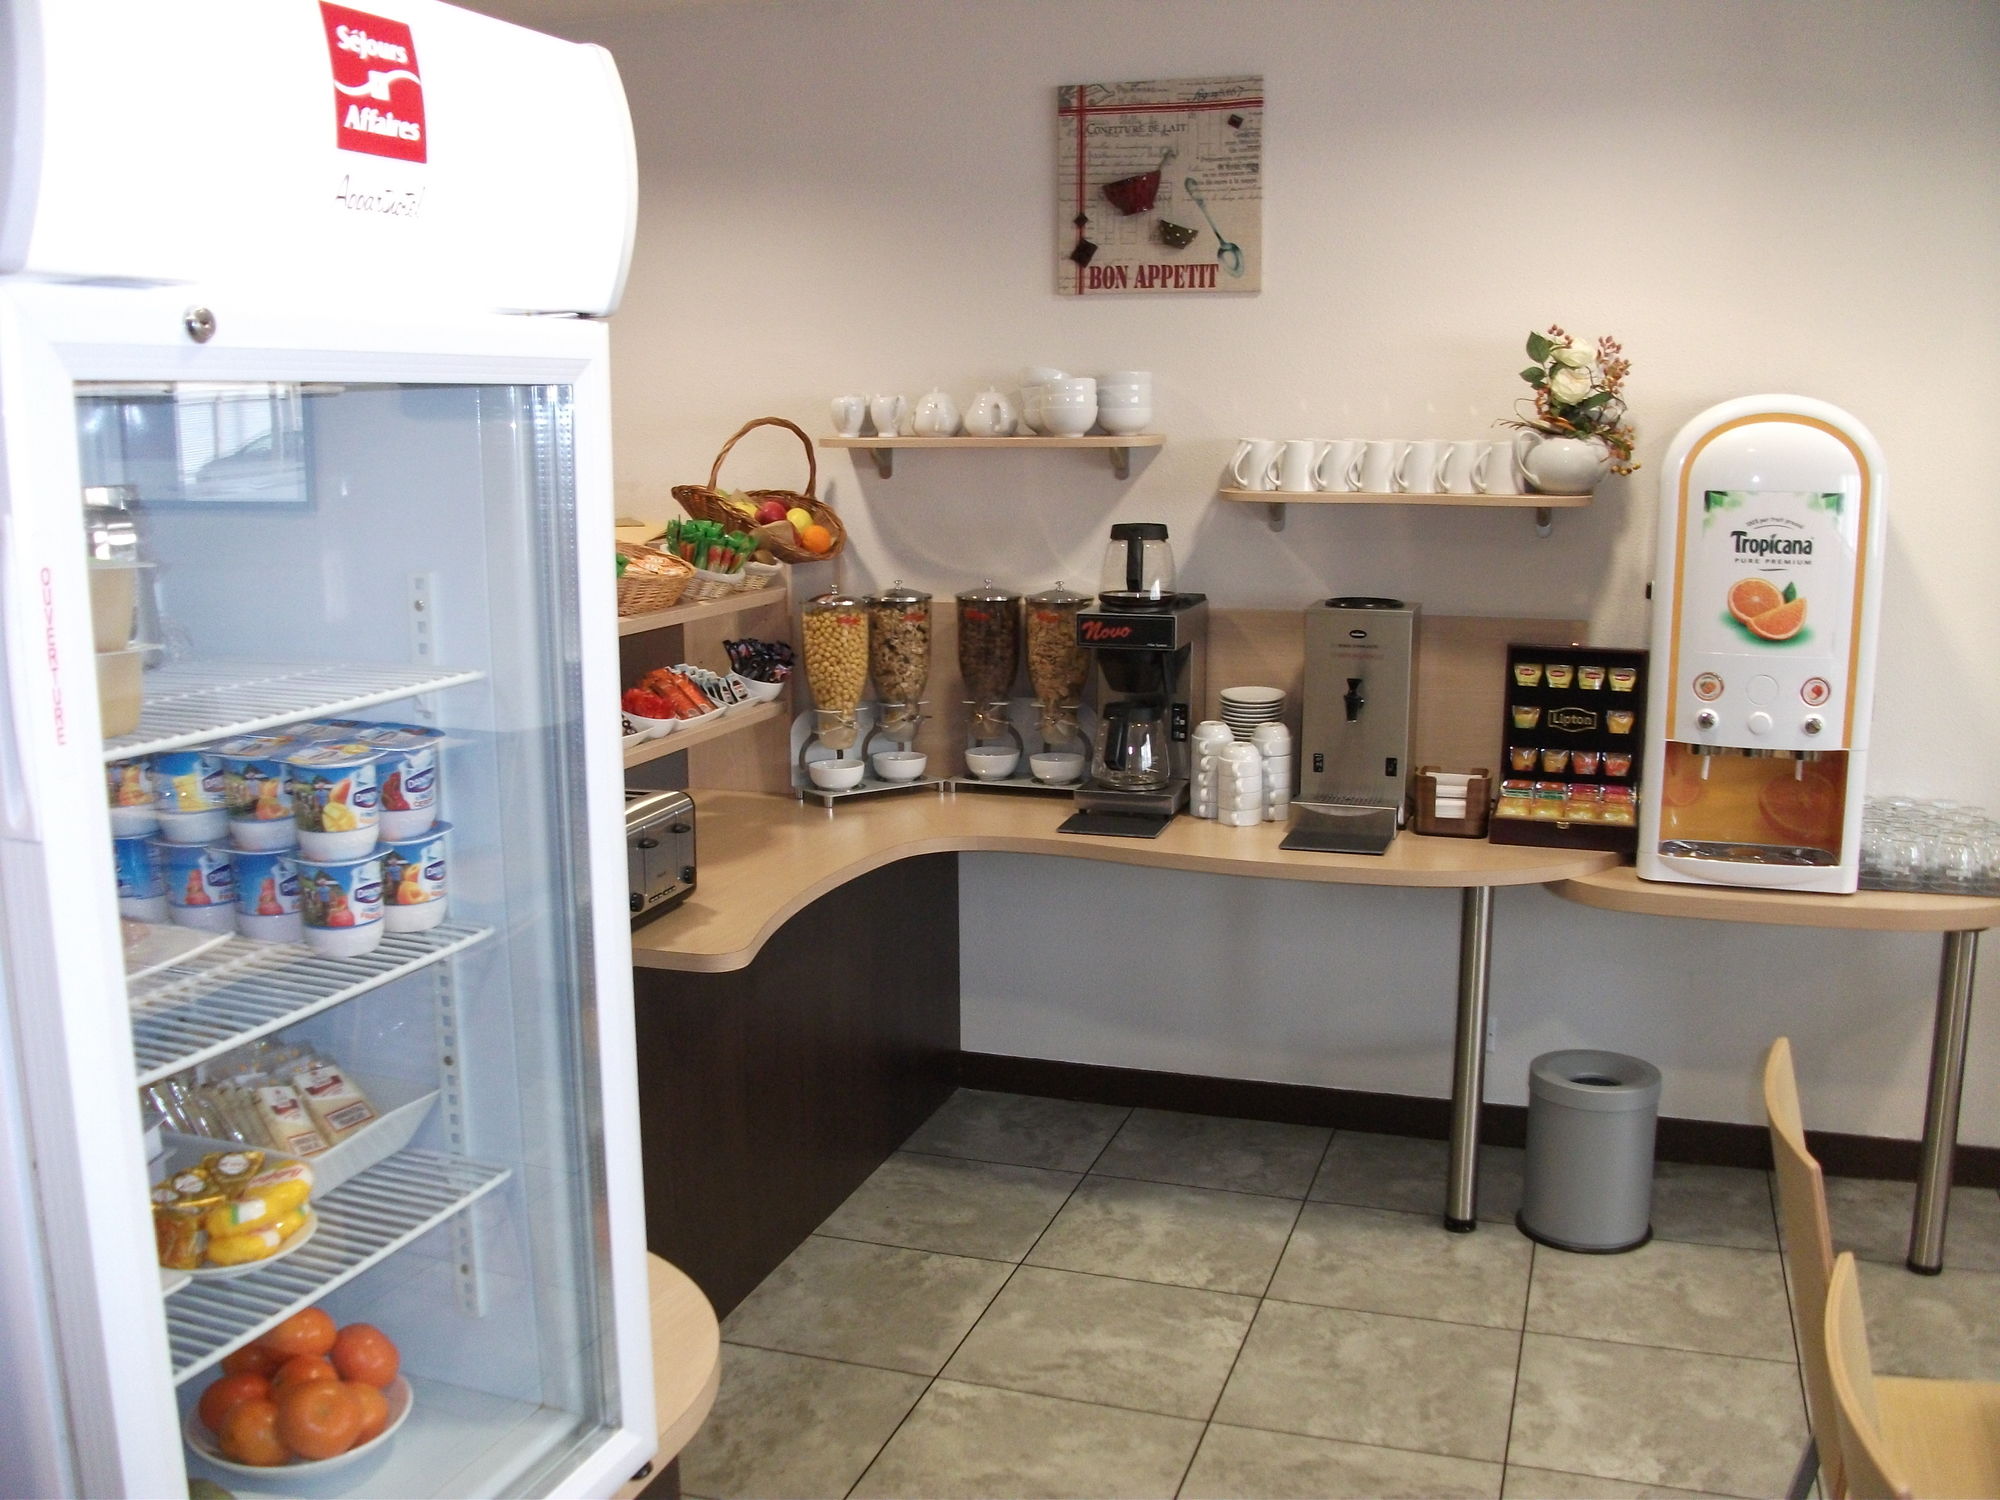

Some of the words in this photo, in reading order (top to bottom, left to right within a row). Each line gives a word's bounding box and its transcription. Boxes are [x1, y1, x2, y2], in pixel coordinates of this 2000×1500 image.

[336, 24, 408, 63] Séjours
[343, 104, 420, 141] Affaires
[1089, 265, 1129, 289] BON
[1134, 263, 1219, 289] APPETIT
[1731, 531, 1813, 556] Tropicana
[1082, 621, 1132, 641] Novo
[41, 567, 66, 746] OUVERTURE
[1552, 712, 1593, 726] Lipton
